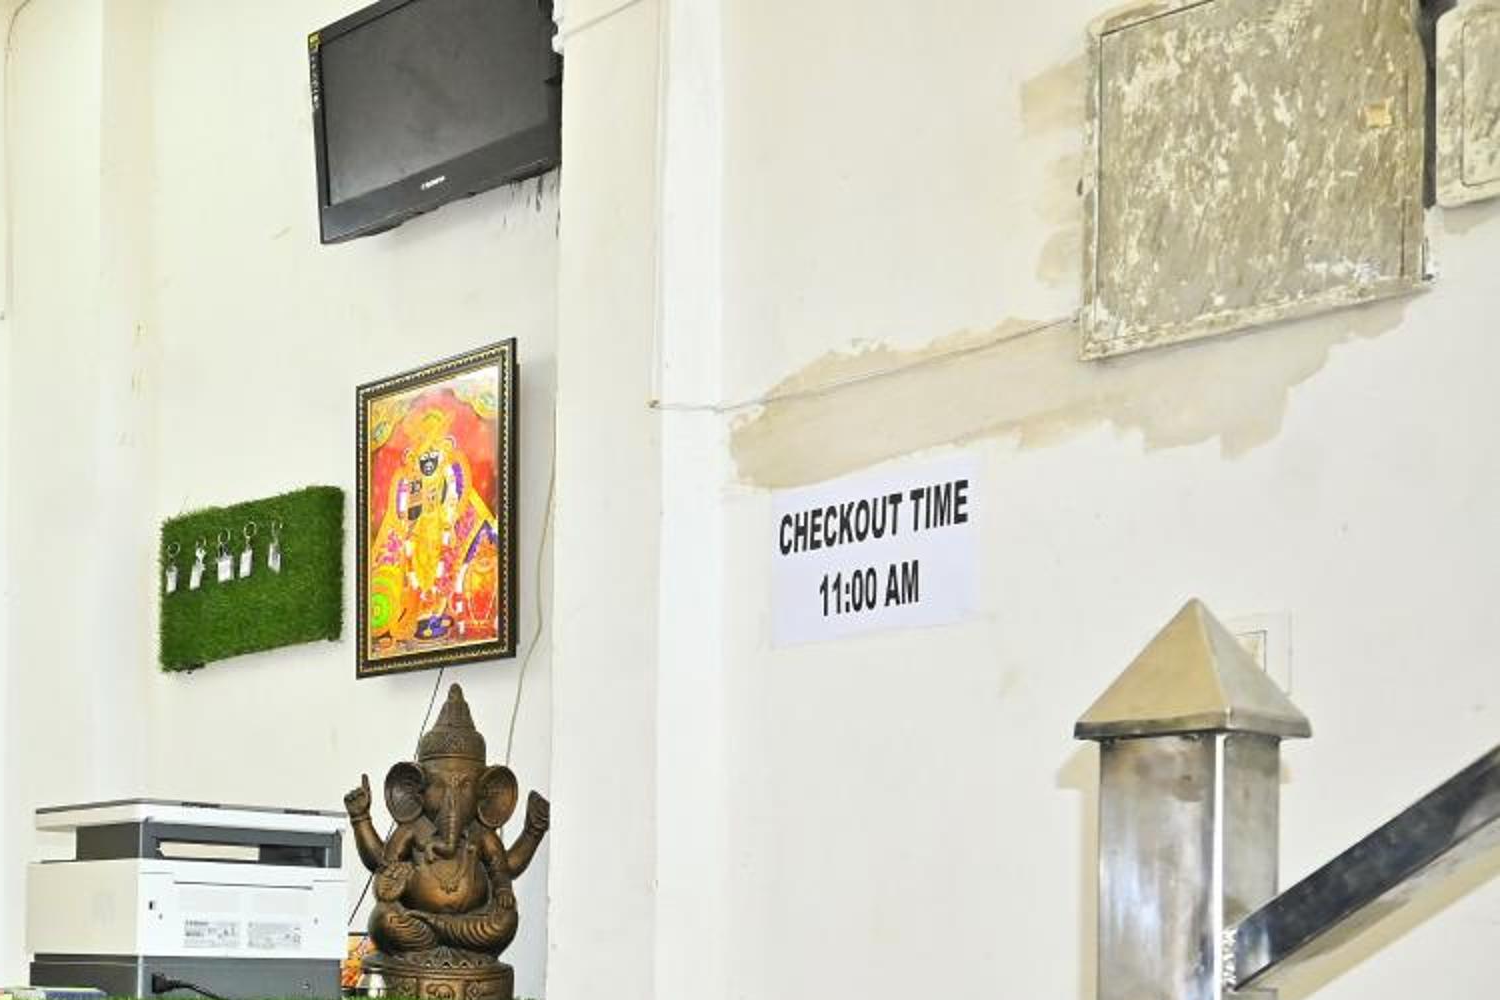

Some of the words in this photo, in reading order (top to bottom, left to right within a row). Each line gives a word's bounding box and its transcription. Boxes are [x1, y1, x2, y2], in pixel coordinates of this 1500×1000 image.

[779, 492, 903, 556] CHECKOUT
[909, 479, 969, 532] TIME
[819, 567, 877, 617] 11:00
[884, 559, 919, 607] AM
